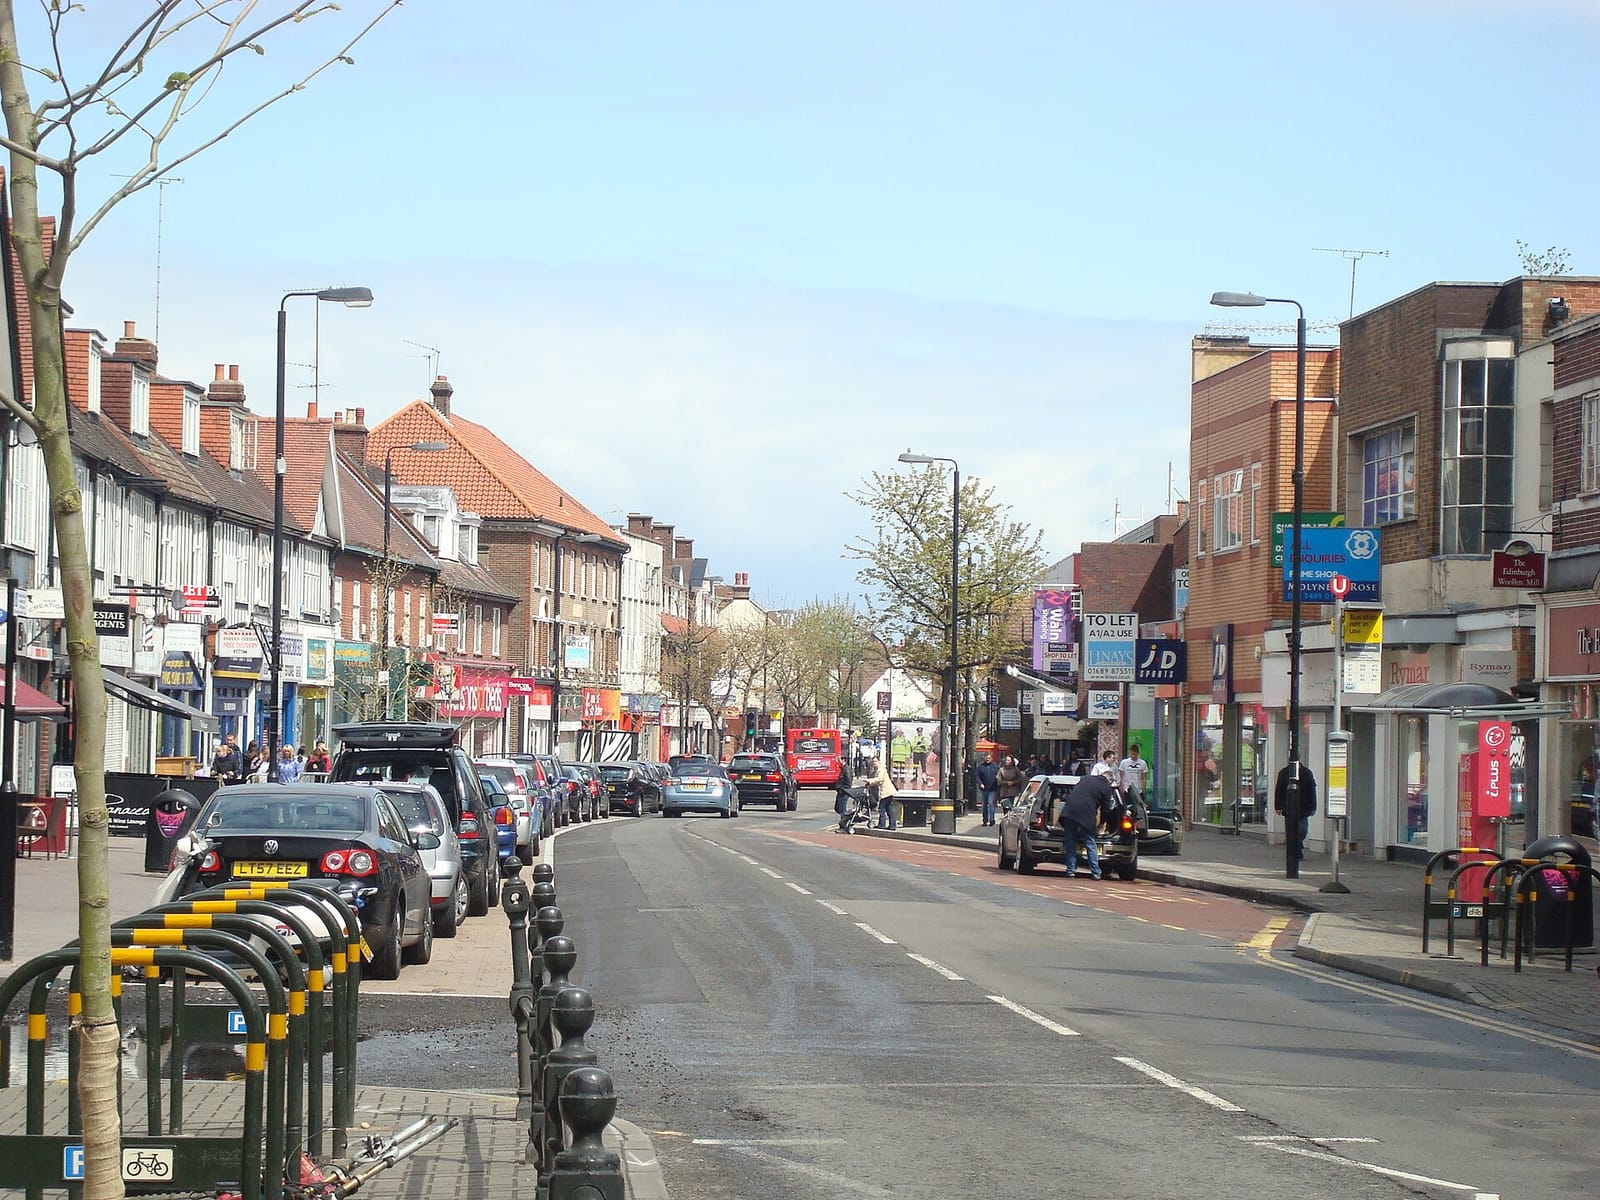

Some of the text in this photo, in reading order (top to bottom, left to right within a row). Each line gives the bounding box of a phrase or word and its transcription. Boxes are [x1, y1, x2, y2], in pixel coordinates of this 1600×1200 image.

[1512, 559, 1526, 567] The
[1501, 567, 1536, 576] Edinburgh
[1497, 577, 1540, 586] Woollen Mill
[94, 610, 125, 620] ESTATE
[94, 620, 126, 629] AGENTS
[1086, 615, 1136, 626] TO LET
[1050, 608, 1062, 643] Waln
[1089, 629, 1133, 638] A1/A2 USE
[1577, 627, 1592, 654] The
[1470, 663, 1511, 671] Ryman
[239, 863, 301, 875] LT57 EEZ
